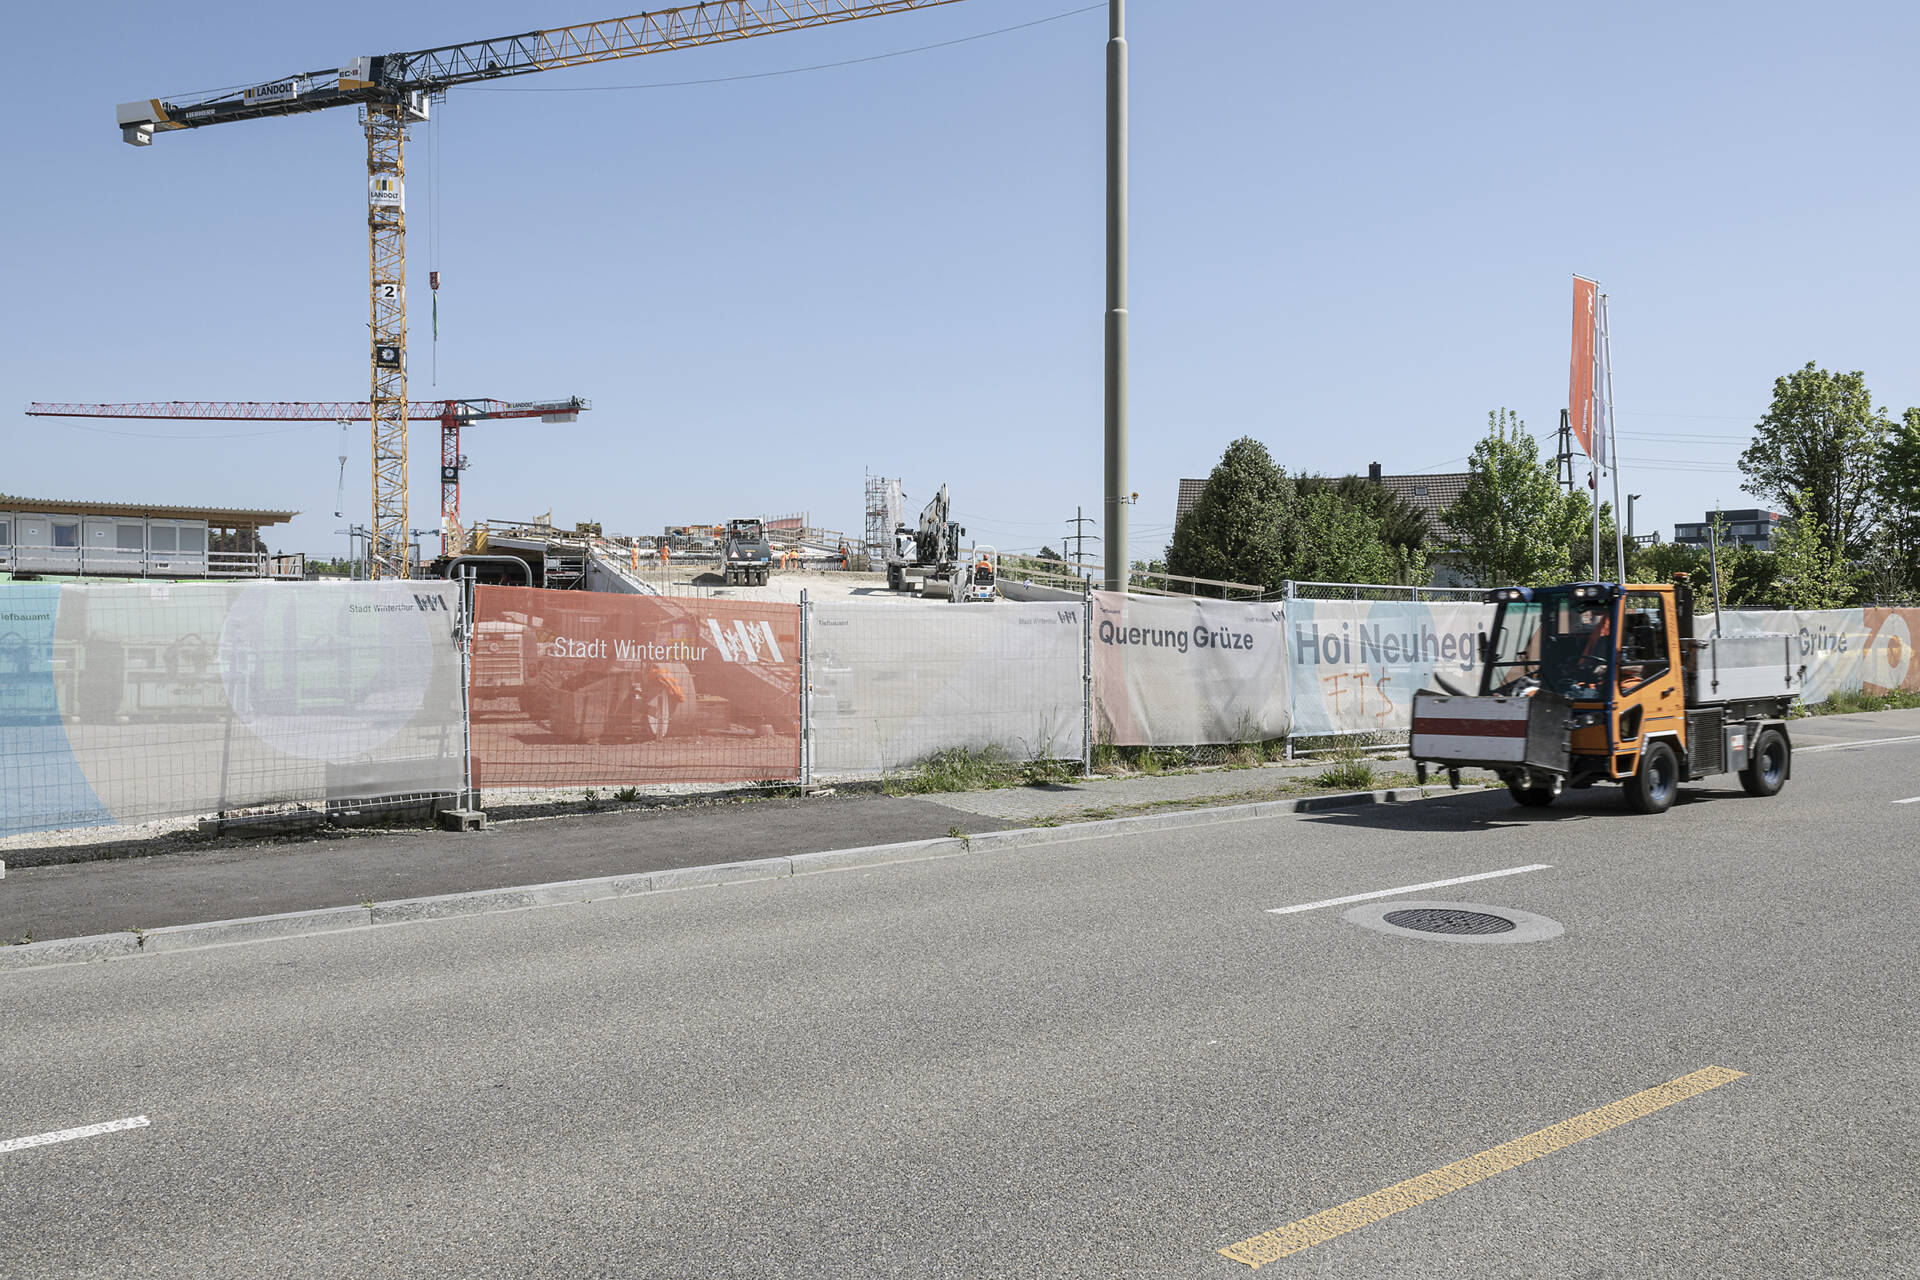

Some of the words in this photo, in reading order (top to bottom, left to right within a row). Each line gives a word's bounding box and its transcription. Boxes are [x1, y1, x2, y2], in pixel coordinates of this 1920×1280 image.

[257, 82, 294, 97] LANDOLT
[370, 191, 399, 199] LANDOLT
[384, 285, 395, 298] 2
[349, 603, 371, 614] Stadt
[0, 612, 50, 621] iefbauamt
[1099, 619, 1188, 654] Querung
[1193, 625, 1254, 650] Grüze
[1799, 625, 1848, 657] Grüze
[553, 636, 608, 660] Stadt
[613, 637, 708, 662] Winterthur
[1295, 622, 1351, 665] Hoi
[1359, 621, 1485, 672] Neuheg
